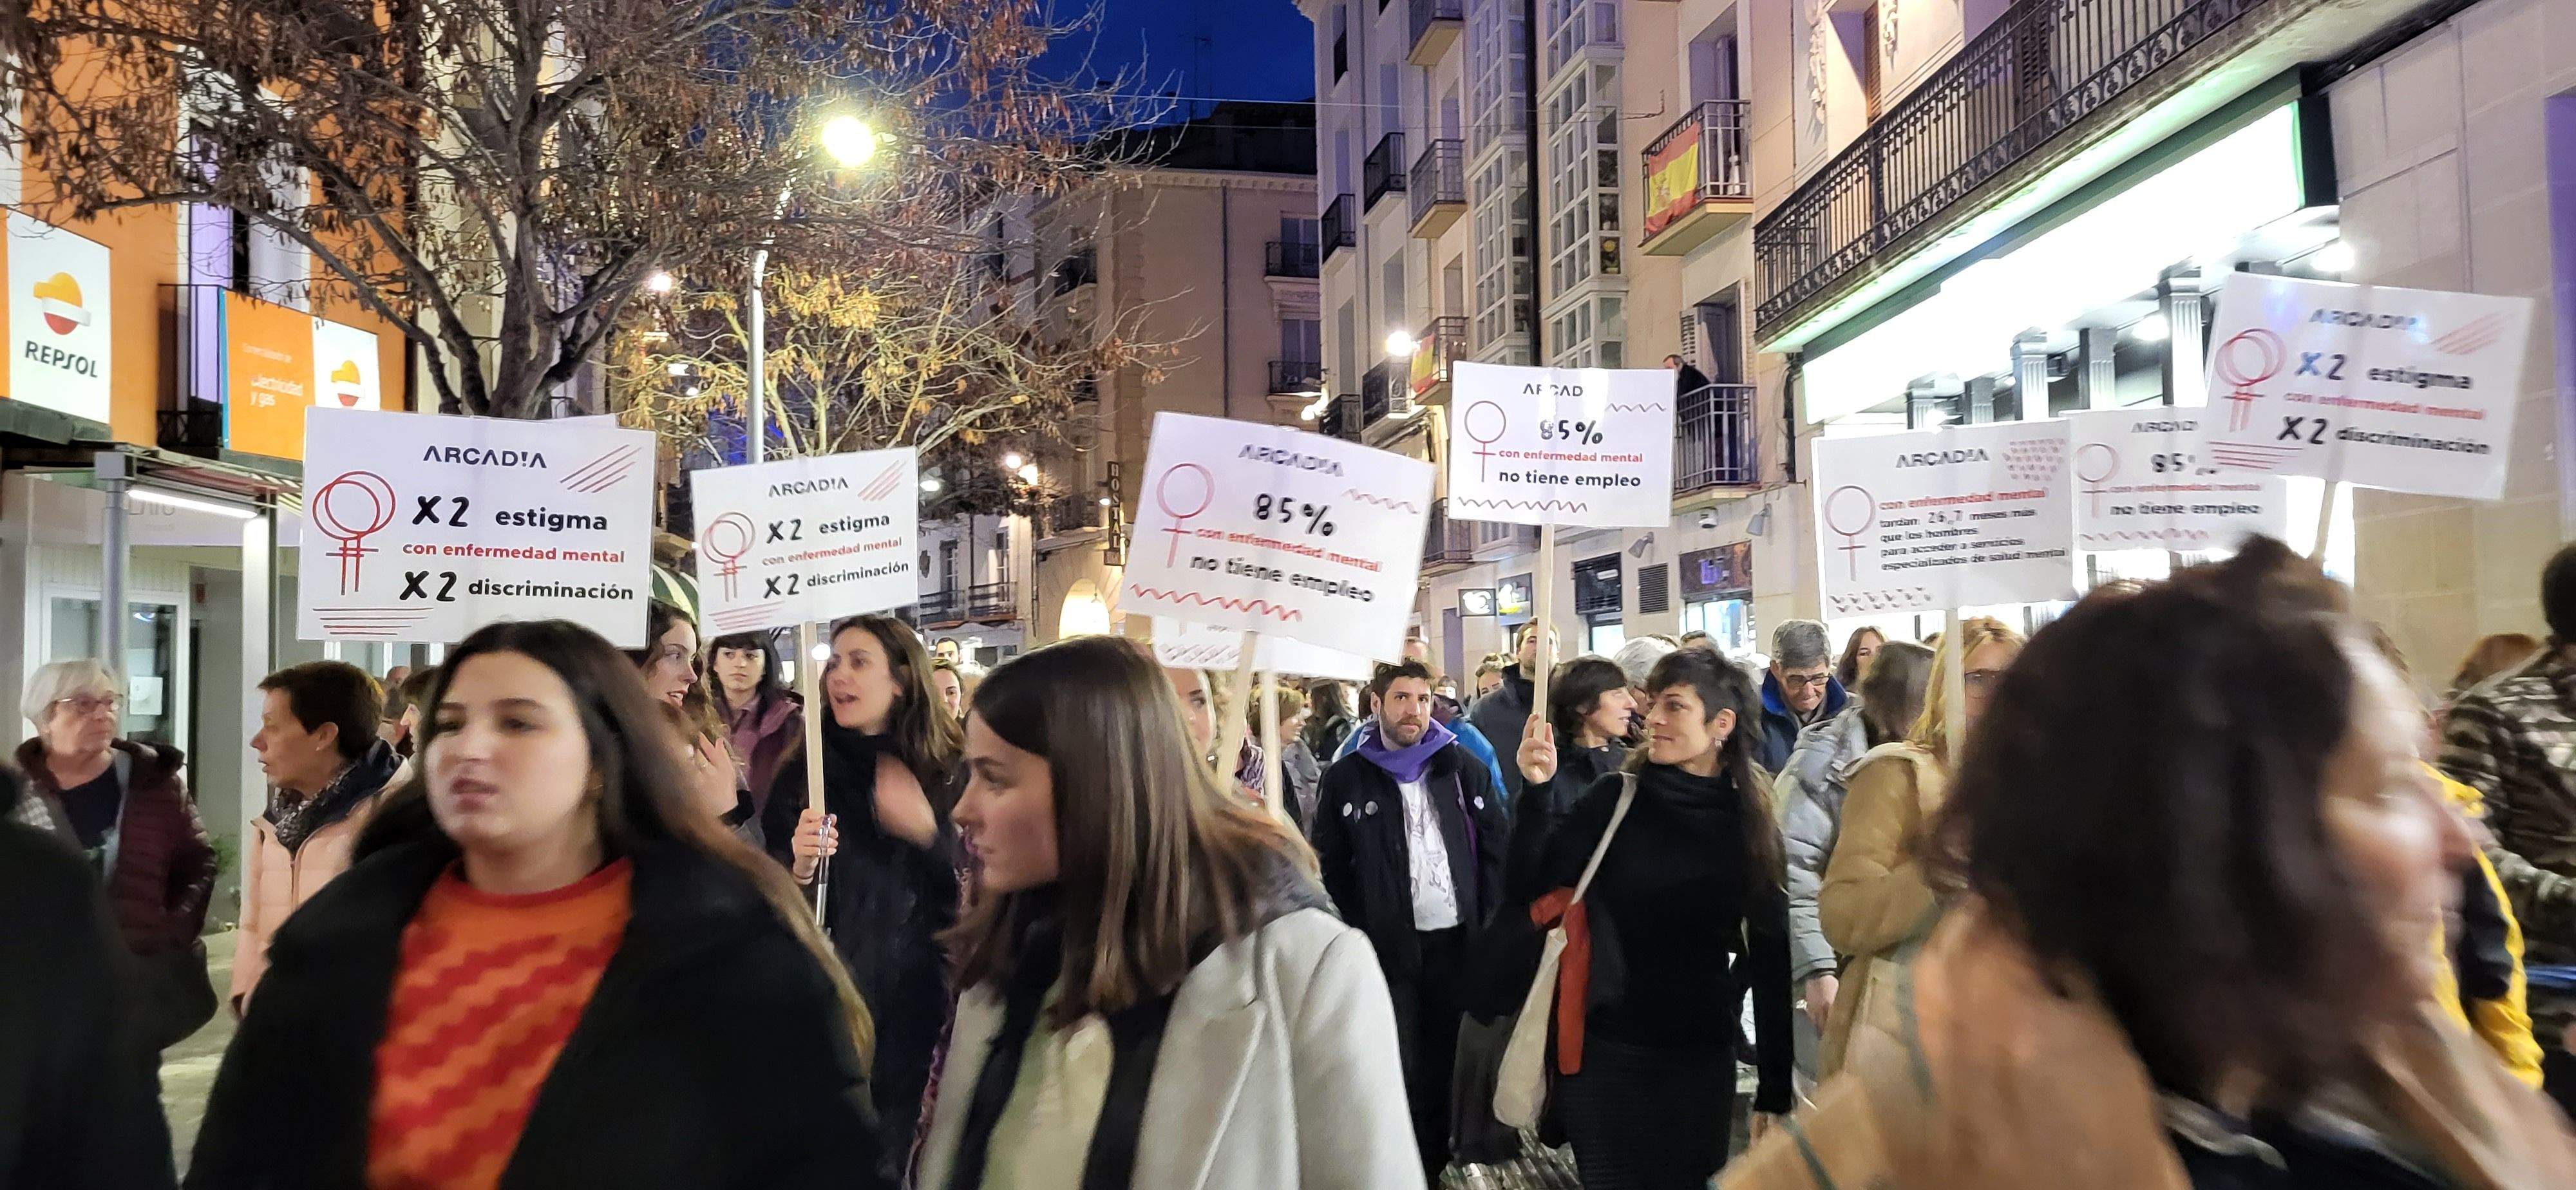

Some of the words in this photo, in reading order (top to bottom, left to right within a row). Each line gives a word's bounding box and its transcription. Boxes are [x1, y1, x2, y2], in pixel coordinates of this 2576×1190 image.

[25, 340, 98, 378] REPSOL
[2367, 366, 2474, 390] estigma
[1539, 419, 1604, 445] 85%
[1524, 449, 1597, 462] enfermedad
[1600, 453, 1643, 462] mental
[1499, 471, 1520, 482] no
[1525, 469, 1569, 485] tiene
[1575, 473, 1641, 489] empleo
[1111, 464, 1120, 548] HOSTAL
[1253, 493, 1338, 536] 85%
[495, 506, 607, 532] estigma
[819, 515, 890, 534] estigma
[1196, 528, 1224, 539] con
[1880, 534, 1903, 543] que
[1906, 531, 1922, 540] los
[402, 543, 437, 554] con
[443, 543, 556, 560] enfermedad
[562, 551, 625, 563] mental
[762, 556, 785, 567] con
[788, 542, 860, 563] enfermedad
[864, 536, 902, 552] mental
[806, 561, 909, 587] discriminación
[1190, 556, 1220, 571] no
[1224, 556, 1285, 583] tiene
[1289, 572, 1376, 603] empleo
[468, 578, 634, 600] discriminación
